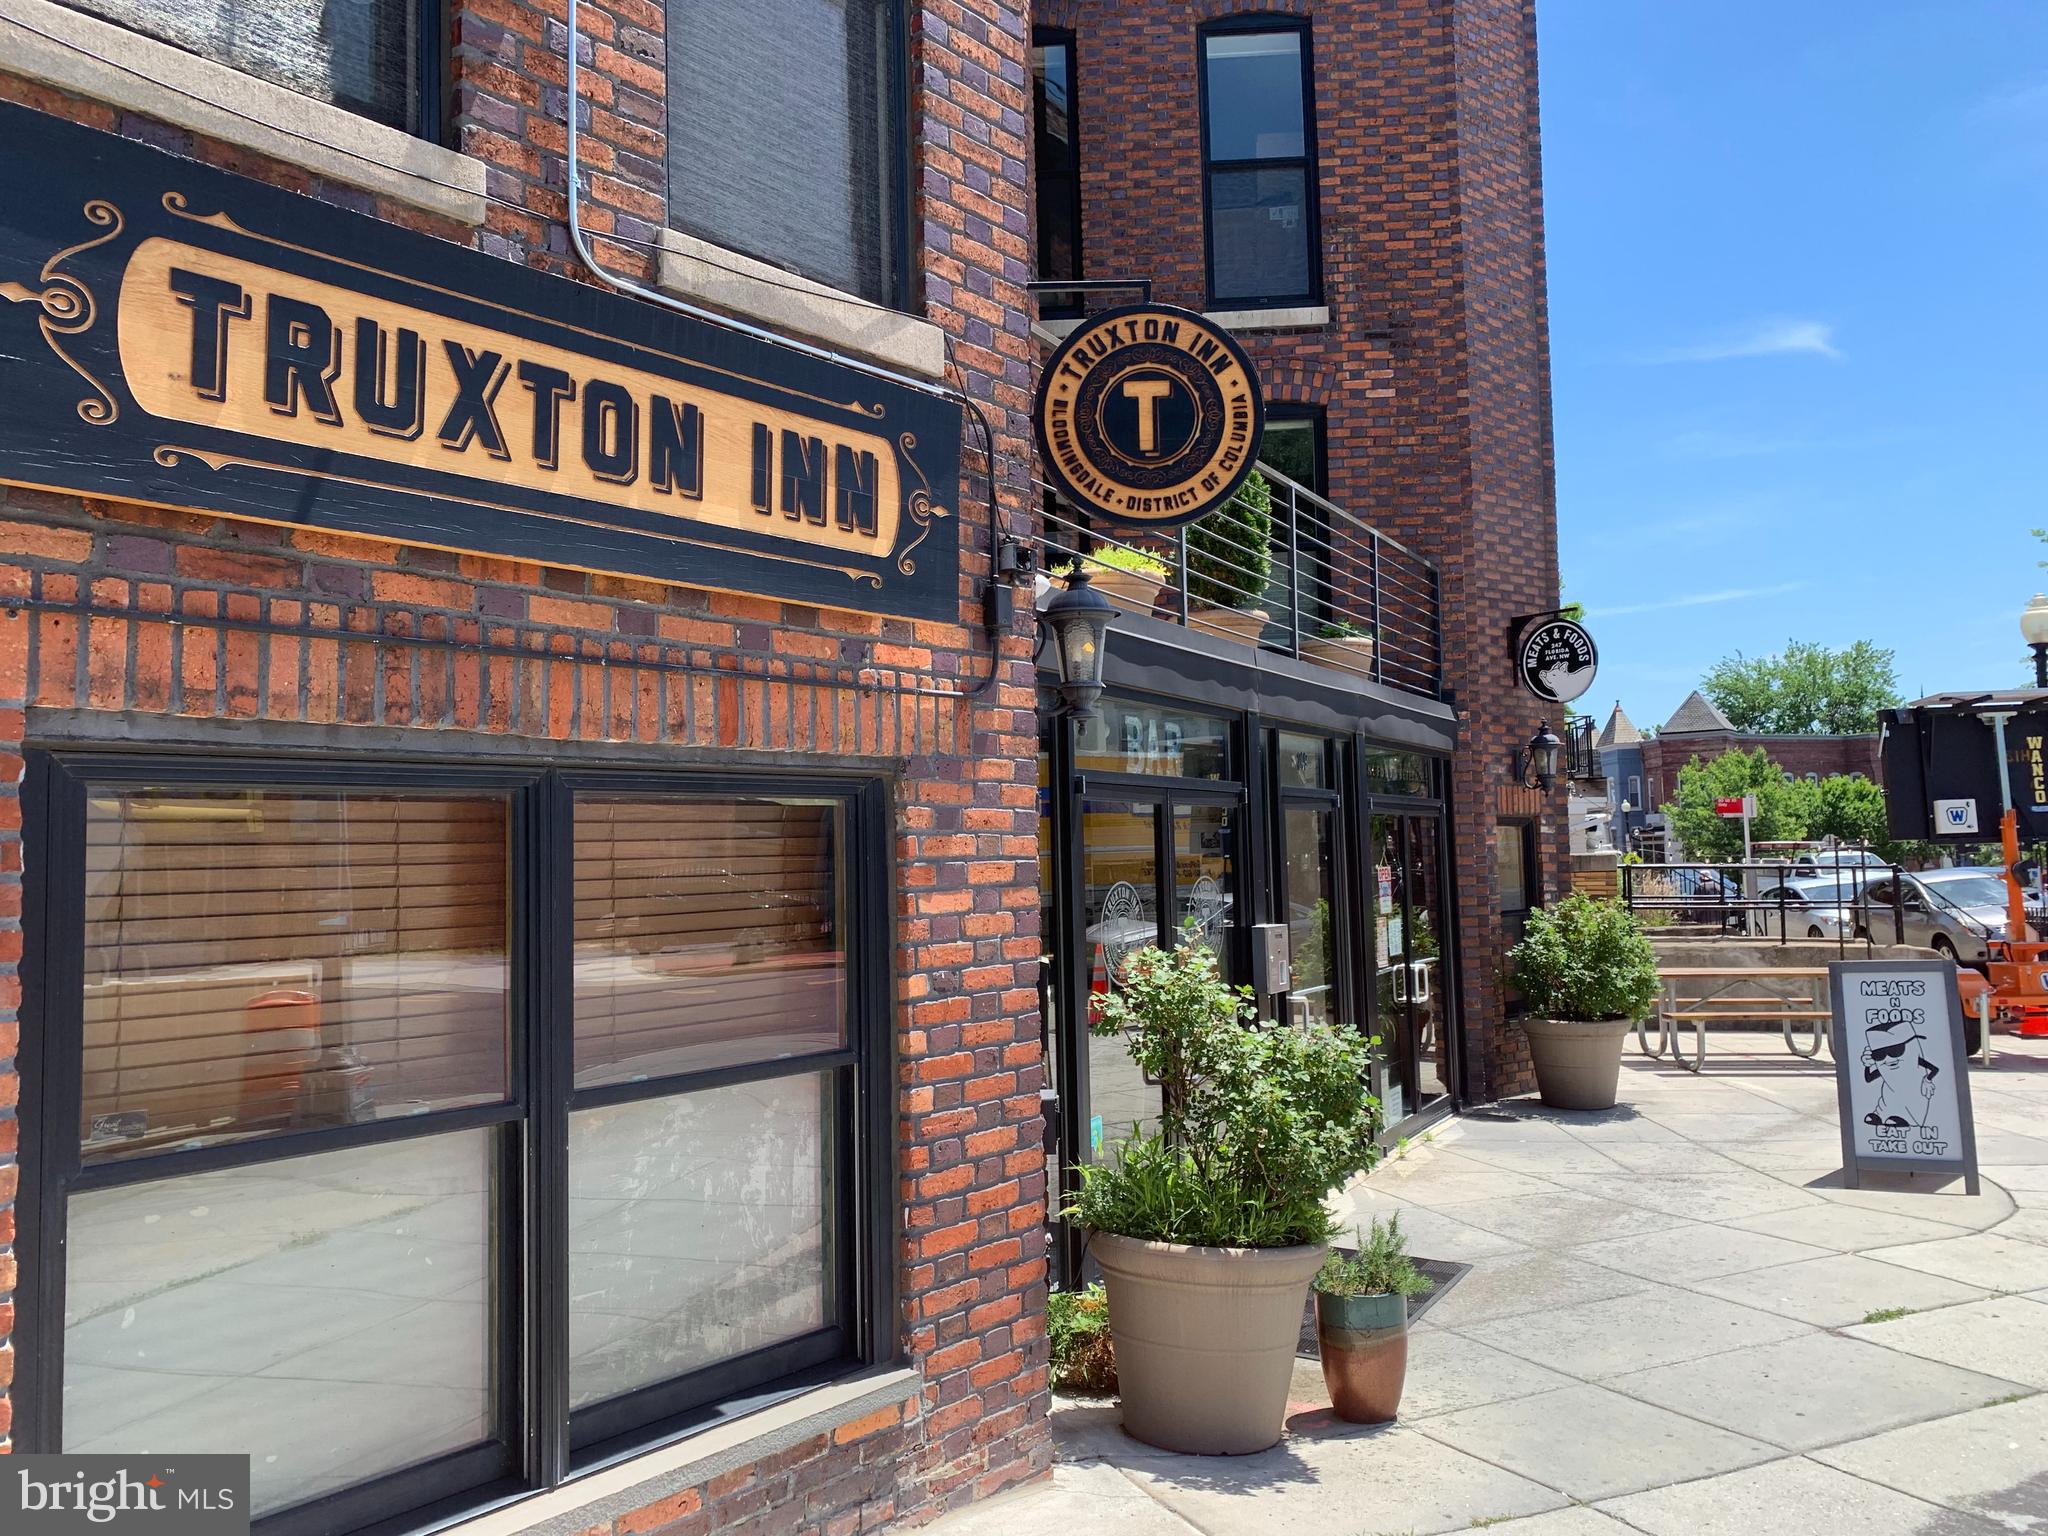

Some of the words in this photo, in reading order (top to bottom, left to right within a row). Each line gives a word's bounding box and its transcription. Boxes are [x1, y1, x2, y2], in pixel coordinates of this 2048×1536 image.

[1061, 319, 1180, 380] TRUXTON
[1188, 333, 1233, 376] INN
[169, 266, 704, 500] TRUXTON
[751, 422, 880, 538] INN
[1123, 379, 1172, 456] T
[1052, 399, 1115, 502] BLOOMINGDALE
[1126, 487, 1199, 512] DISTRICT
[1200, 472, 1221, 492] OF
[1218, 393, 1248, 472] COLUMBIA
[1527, 632, 1550, 668] MEATS
[1553, 628, 1560, 639] &
[1563, 629, 1589, 662] FOODS
[2026, 736, 2047, 803] WANCO
[1949, 810, 1964, 822] W
[1105, 887, 1130, 916] TRUXTON
[1860, 980, 1926, 997] MEATS
[1890, 997, 1900, 1007] N
[1865, 1008, 1925, 1025] FOODS
[1868, 1139, 1907, 1153] TAKE
[1913, 1141, 1948, 1155] OUT
[1876, 1125, 1911, 1139] EAT
[1920, 1125, 1939, 1140] IN
